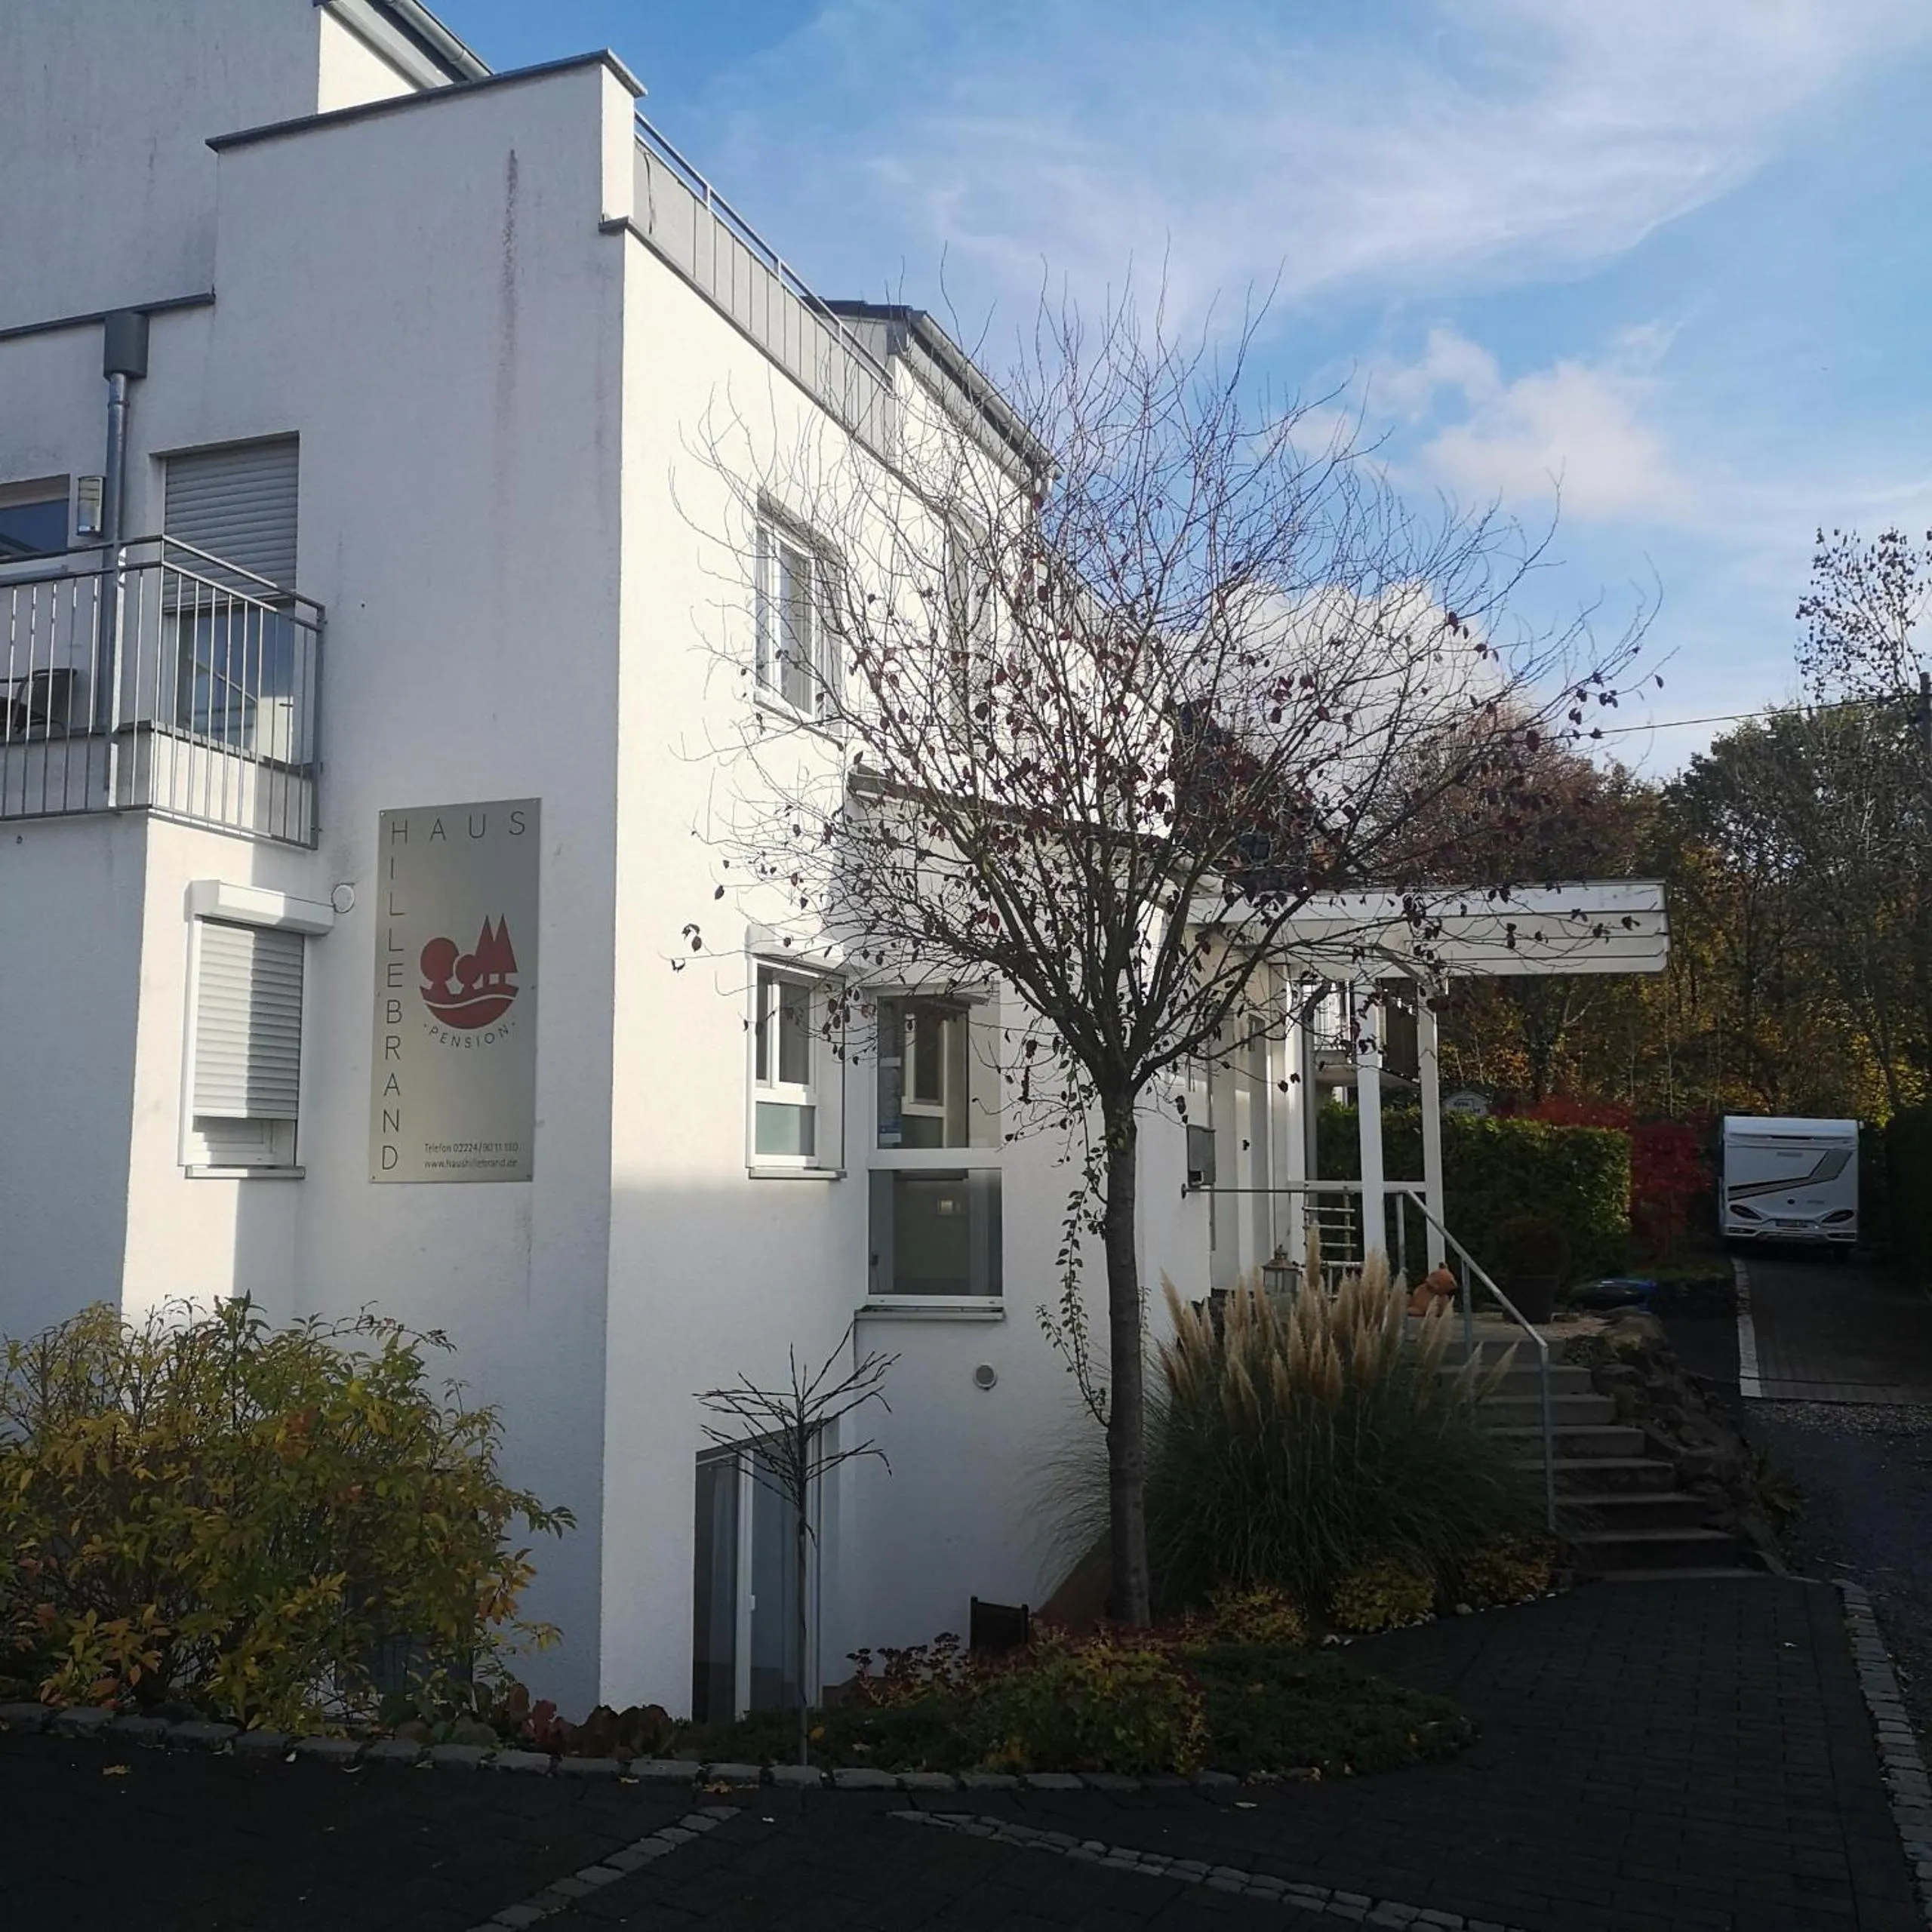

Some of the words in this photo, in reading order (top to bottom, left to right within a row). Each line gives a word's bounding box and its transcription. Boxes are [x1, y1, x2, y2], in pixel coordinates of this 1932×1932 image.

[392, 811, 526, 846] HAUS
[429, 1024, 509, 1049] PENSION
[424, 1143, 451, 1153] Telefon
